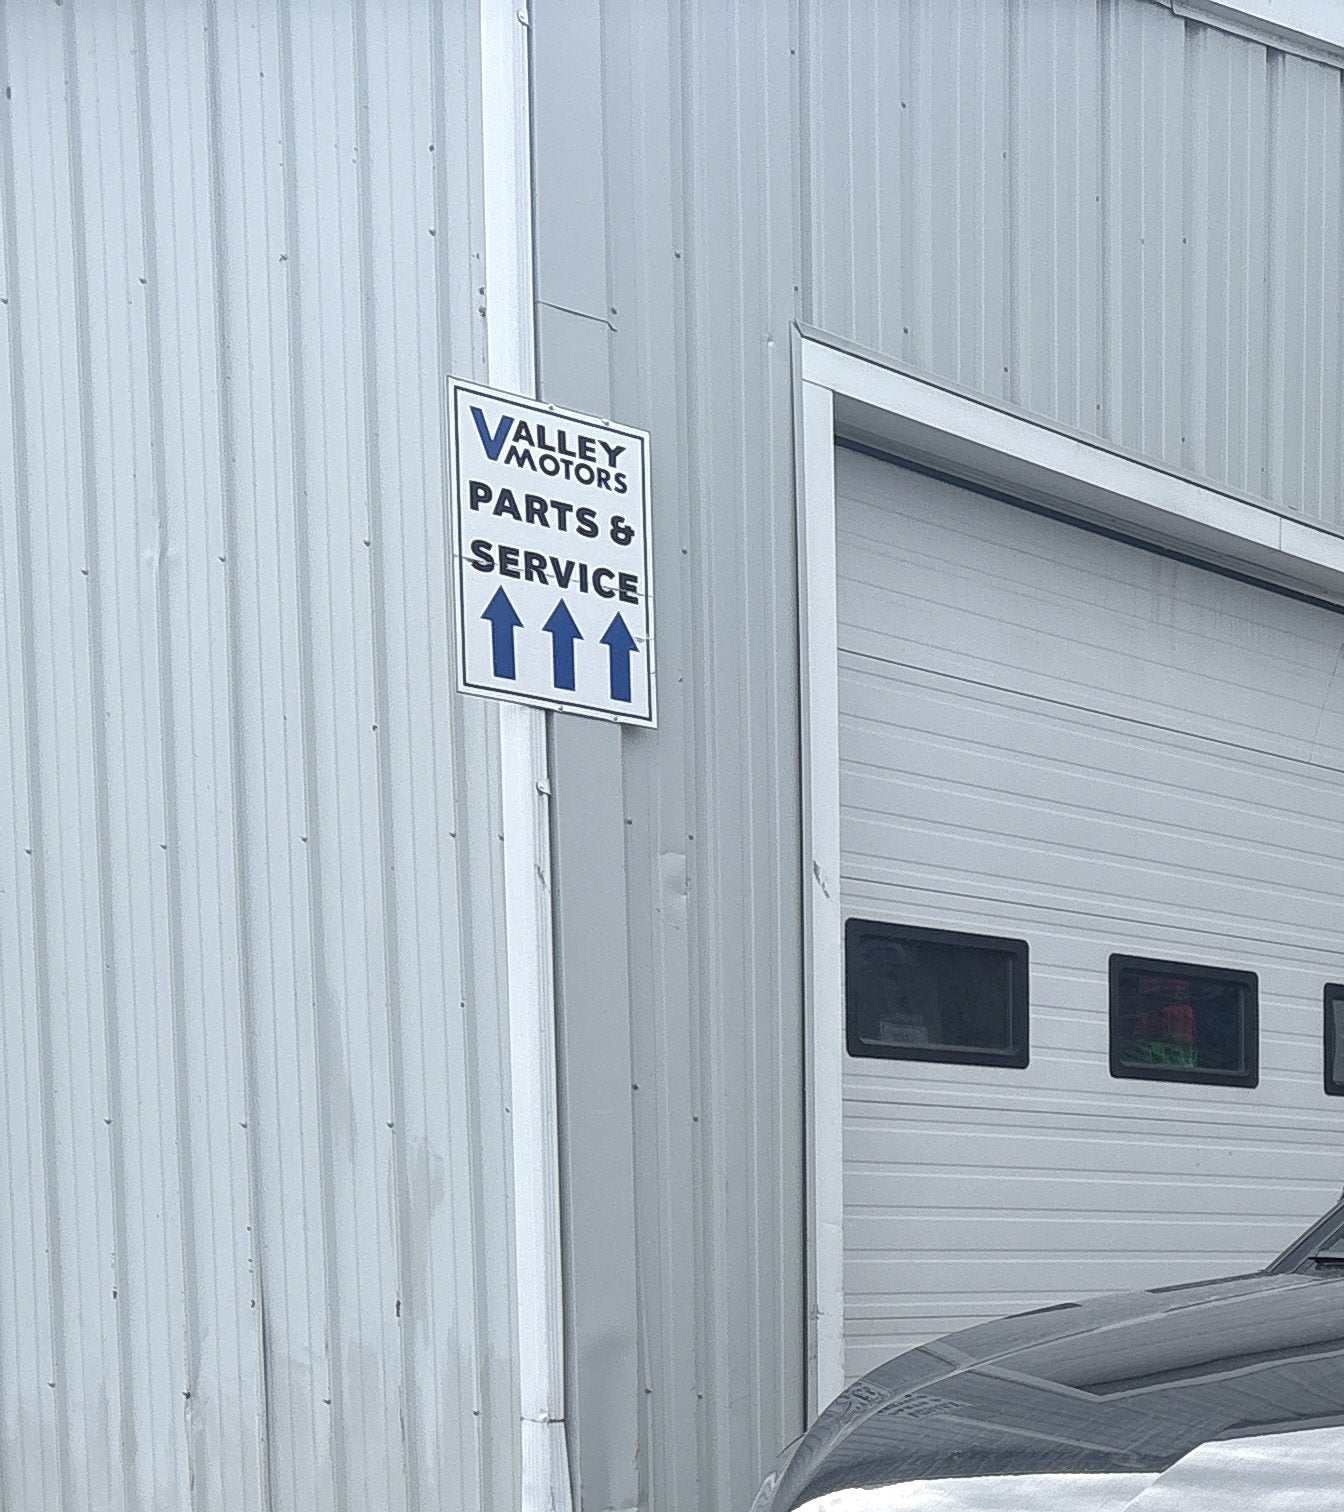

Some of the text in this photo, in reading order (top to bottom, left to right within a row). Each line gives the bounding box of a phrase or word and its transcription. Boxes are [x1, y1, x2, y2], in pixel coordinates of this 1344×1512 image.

[469, 405, 627, 469] VALLEY
[504, 445, 628, 494] MOTORS
[469, 480, 635, 547] PARTS &
[470, 539, 639, 605] SERVICE
